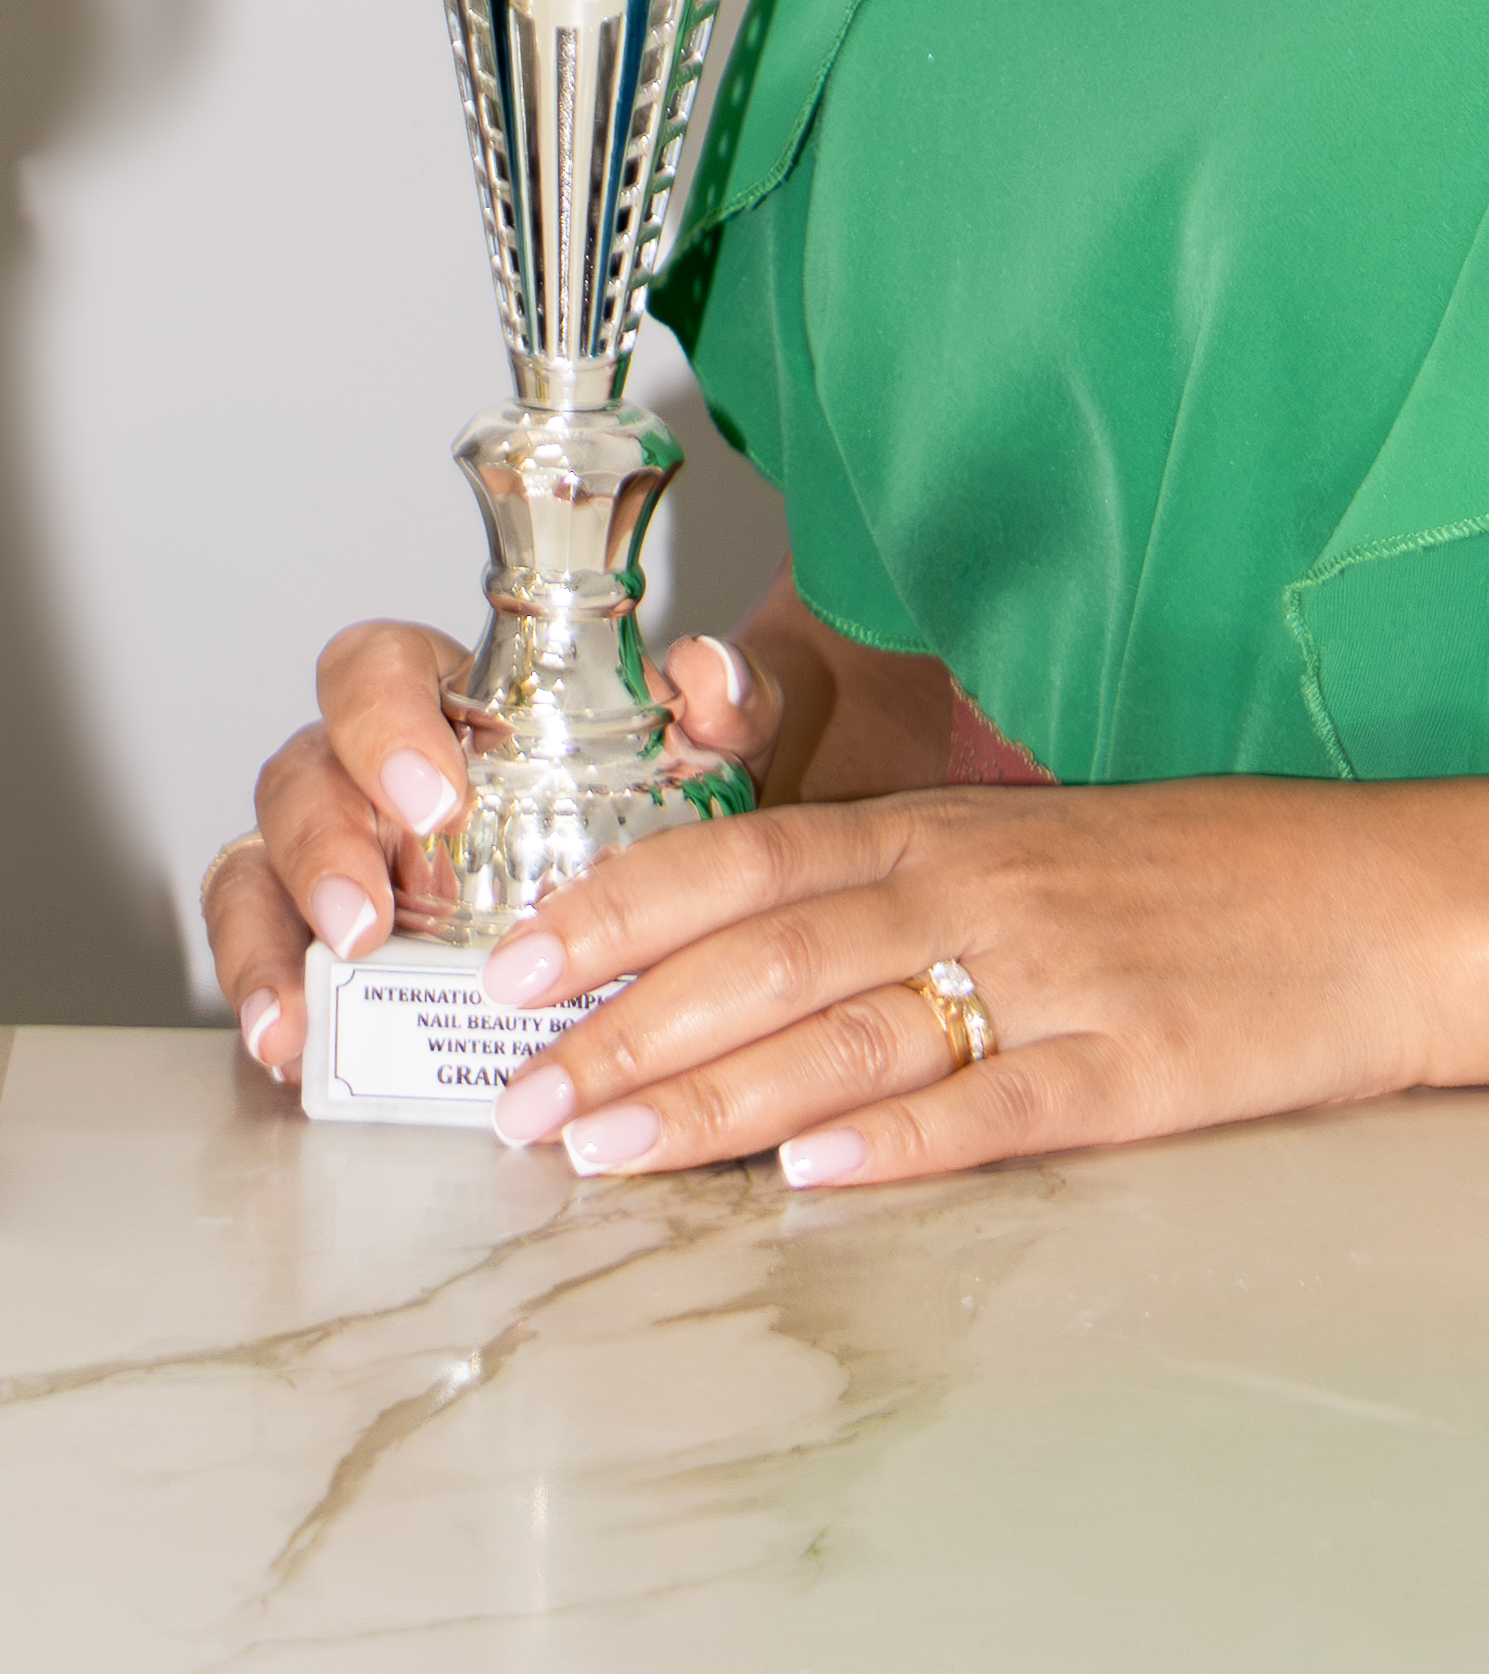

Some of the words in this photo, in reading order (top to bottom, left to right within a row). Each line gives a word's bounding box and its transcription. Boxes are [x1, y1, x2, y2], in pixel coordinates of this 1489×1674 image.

[364, 986, 482, 1005] INTERNATIO
[417, 1012, 461, 1029] NAIL
[467, 1014, 544, 1032] BEAUTY
[427, 1037, 506, 1055] WINTER
[437, 1064, 514, 1087] GRAN
